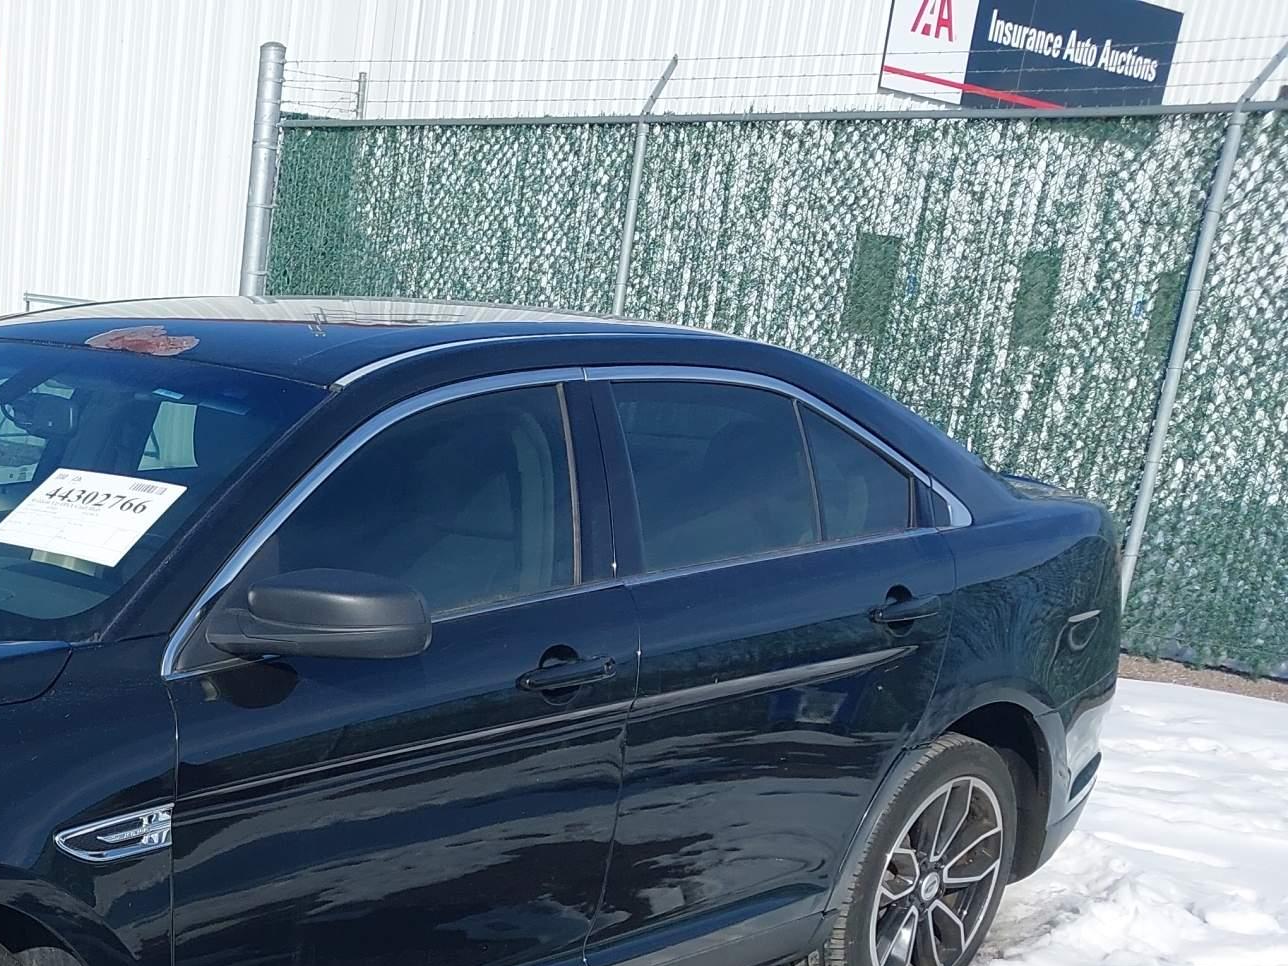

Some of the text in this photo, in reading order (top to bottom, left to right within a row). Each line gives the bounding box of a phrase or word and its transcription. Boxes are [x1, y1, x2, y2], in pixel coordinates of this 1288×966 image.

[987, 9, 1158, 82] Insurance Auto Auctions
[45, 486, 153, 515] 44302766
